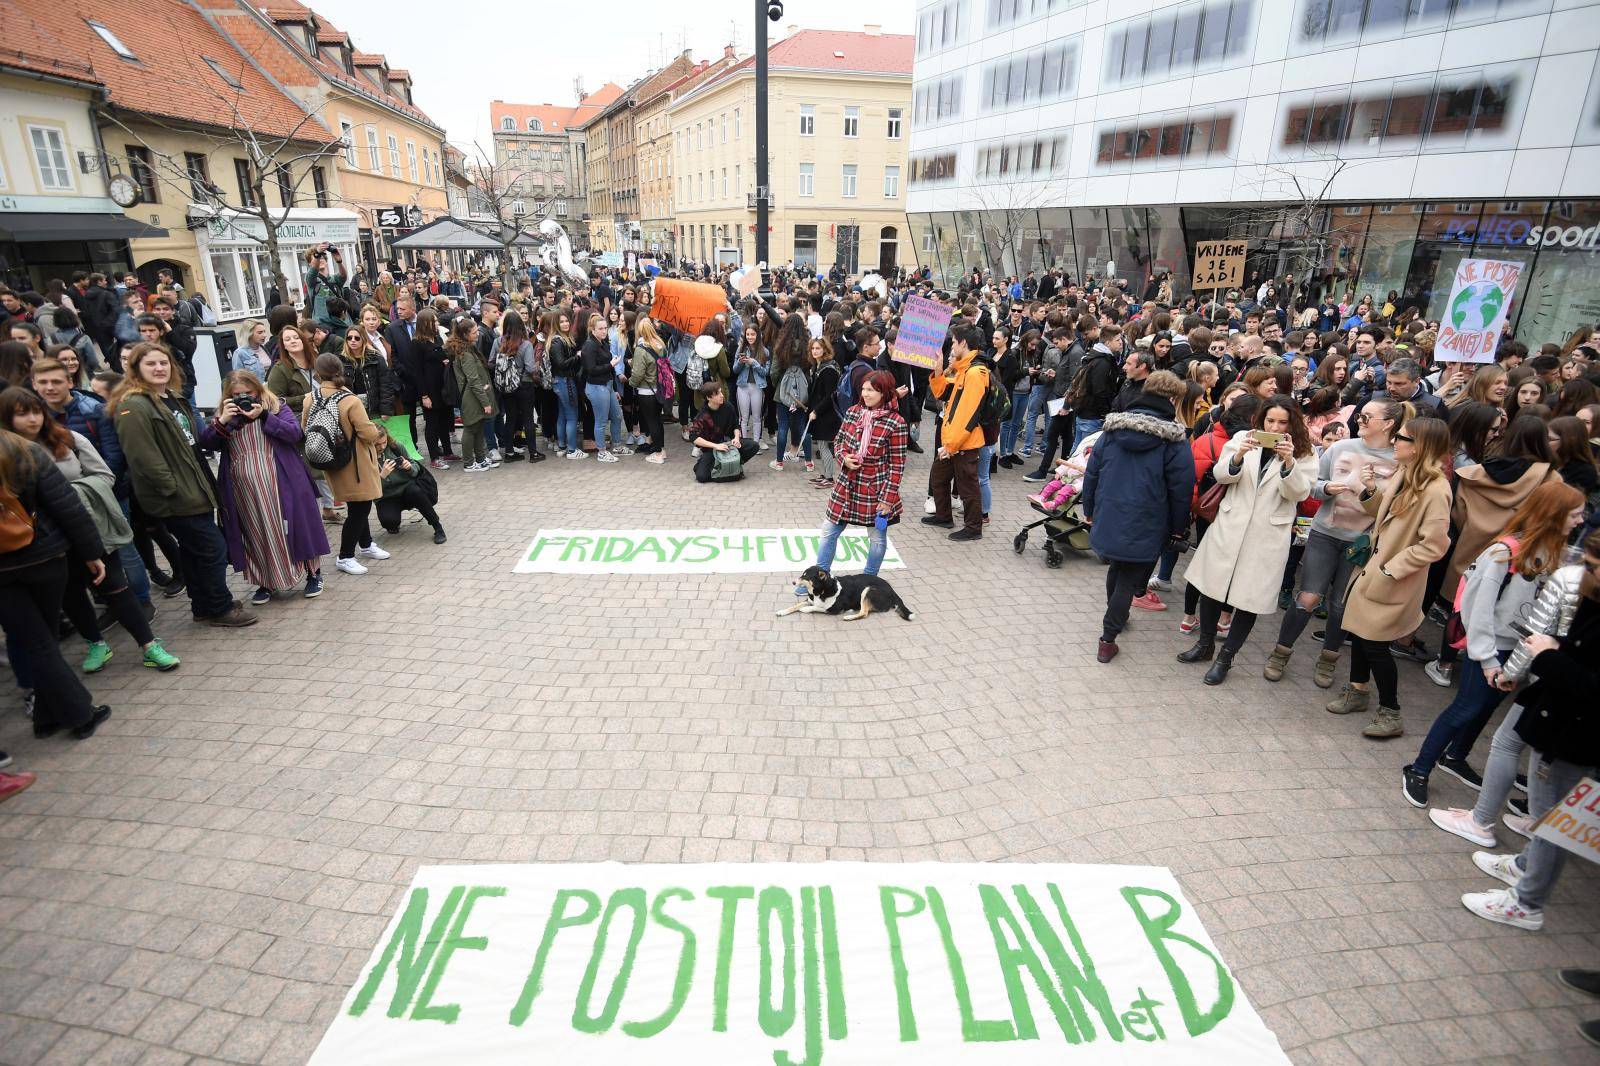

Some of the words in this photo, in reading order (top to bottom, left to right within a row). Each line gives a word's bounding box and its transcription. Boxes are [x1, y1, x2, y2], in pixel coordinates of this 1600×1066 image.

[277, 224, 316, 238] ROMATICA
[1198, 244, 1245, 258] VRIJEME
[1196, 267, 1236, 283] SAD!
[1208, 260, 1226, 270] JE
[1458, 262, 1477, 287] NE
[1482, 332, 1495, 353] B
[1565, 783, 1592, 807] B
[1543, 809, 1600, 853] OSTOJI
[347, 885, 507, 1024] NE
[508, 885, 848, 1066] POSTOJI
[1119, 886, 1235, 1038] B
